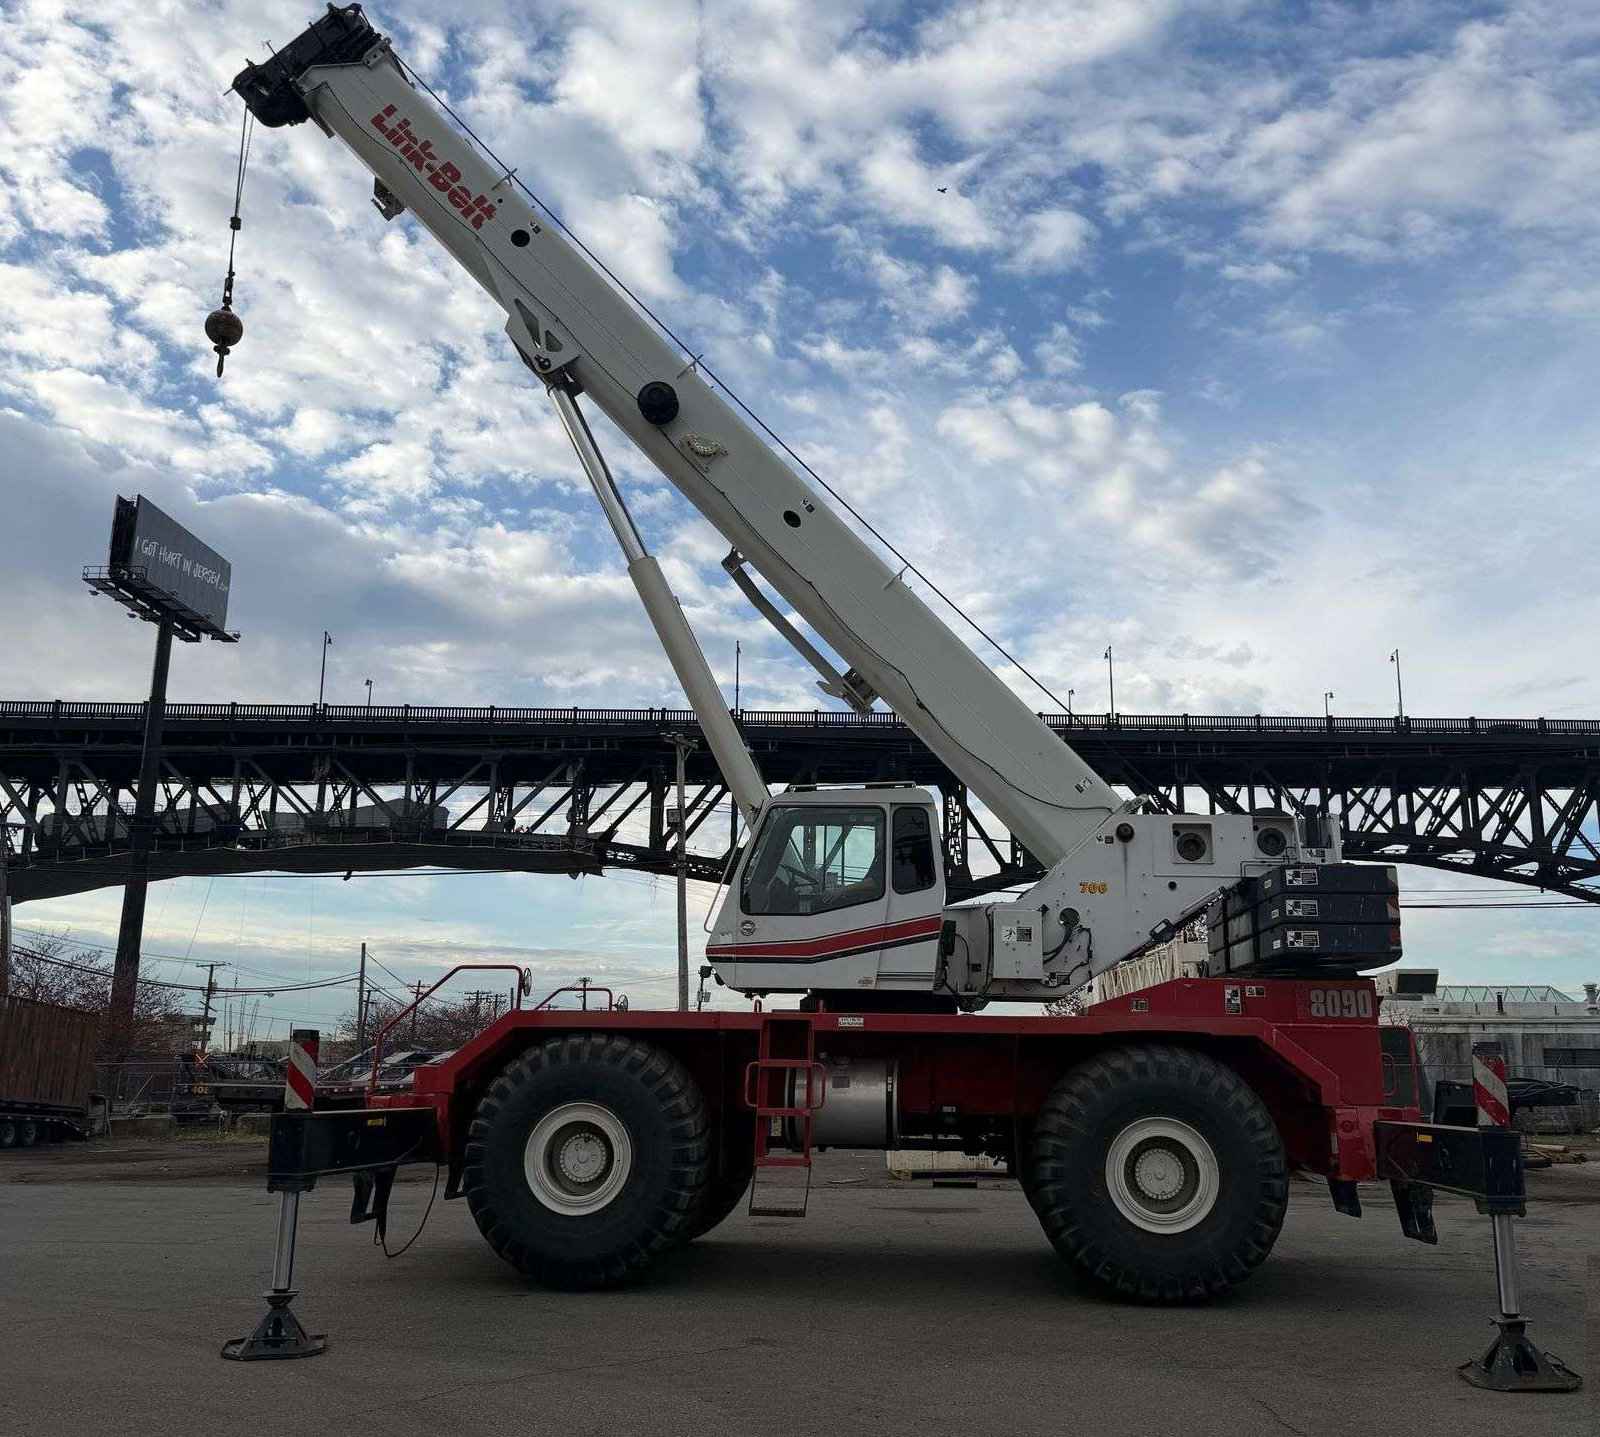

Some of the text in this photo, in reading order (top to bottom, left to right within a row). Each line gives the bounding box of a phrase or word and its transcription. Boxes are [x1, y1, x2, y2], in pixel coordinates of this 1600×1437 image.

[371, 104, 497, 231] Link-Belt
[141, 539, 160, 557] GOT
[159, 545, 183, 570] HURT
[1310, 989, 1373, 1018] 8090
